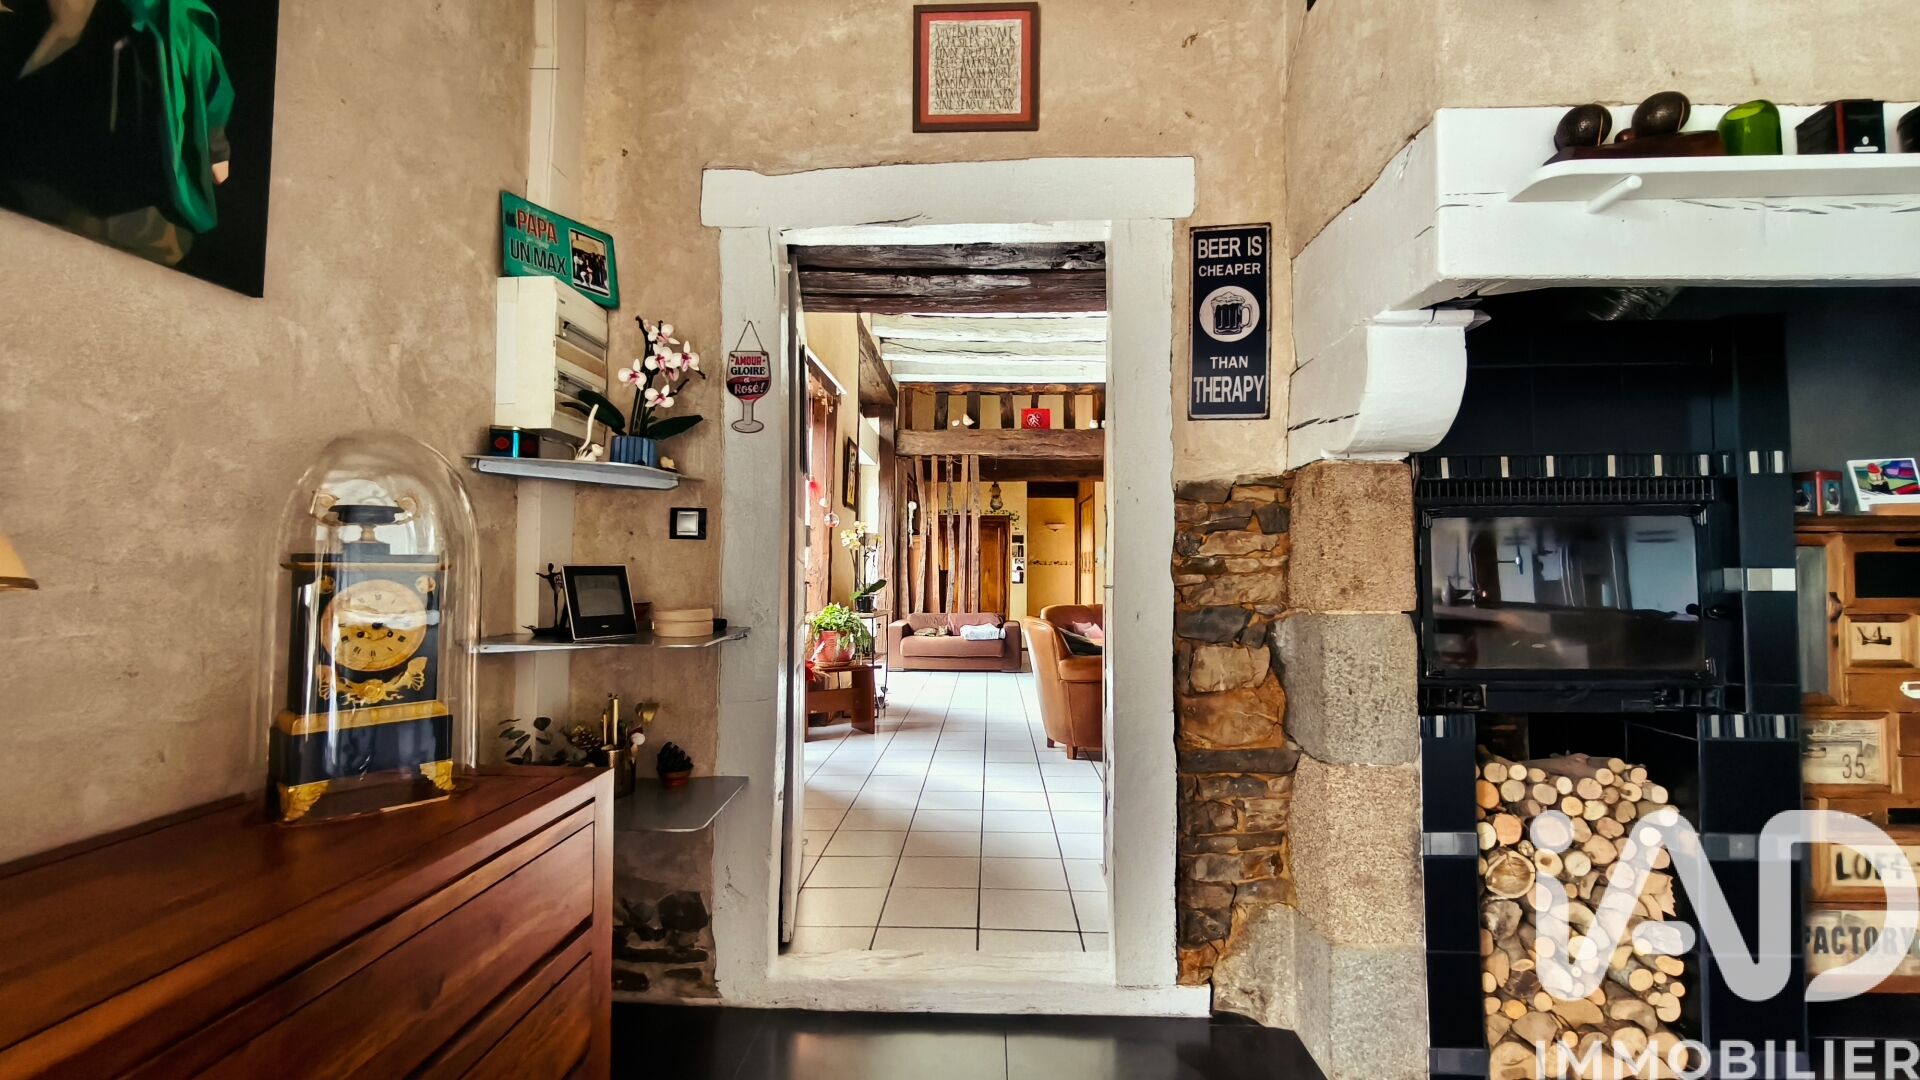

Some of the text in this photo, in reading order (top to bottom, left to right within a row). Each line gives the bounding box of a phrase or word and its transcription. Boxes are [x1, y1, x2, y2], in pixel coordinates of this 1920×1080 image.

[516, 208, 558, 244] PAPA
[509, 238, 531, 264] UN
[533, 247, 567, 277] MAX
[1197, 235, 1263, 259] BEER IS
[1198, 262, 1261, 277] CHEAPER
[730, 366, 766, 375] GLOIRE
[735, 355, 762, 366] AMOUR
[1209, 356, 1249, 369] THAN
[1193, 375, 1265, 403] THERAPY
[1842, 754, 1866, 779] 35
